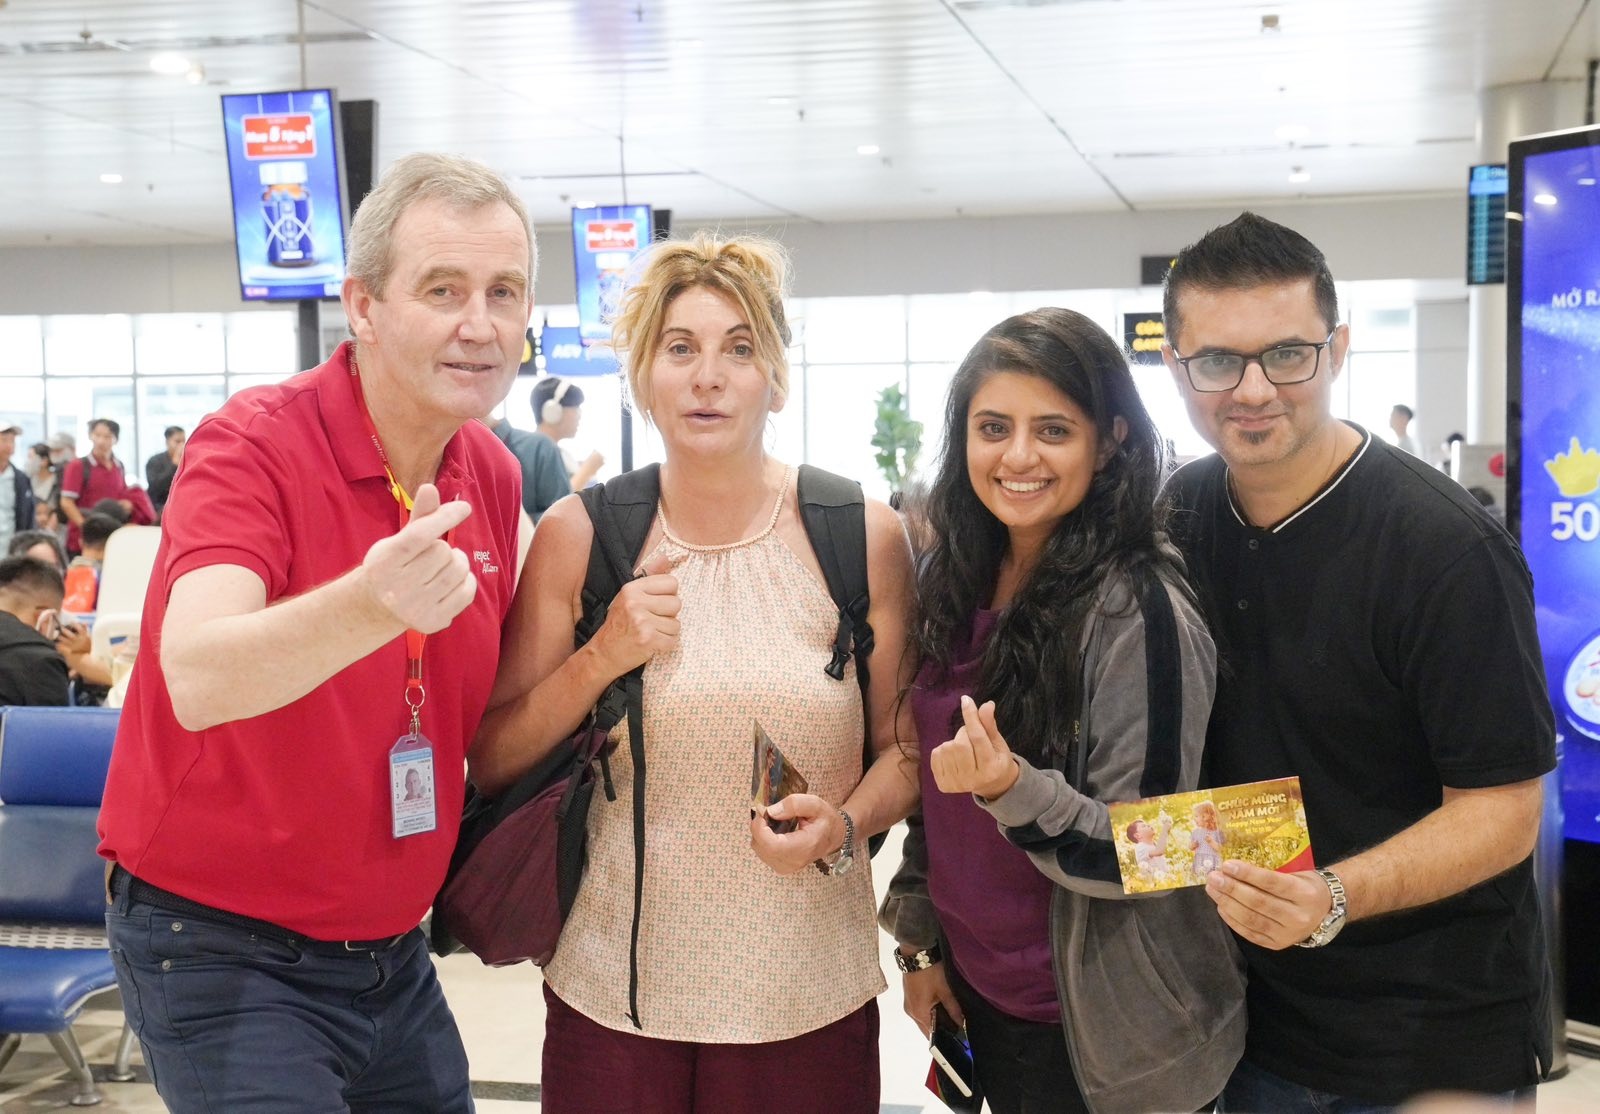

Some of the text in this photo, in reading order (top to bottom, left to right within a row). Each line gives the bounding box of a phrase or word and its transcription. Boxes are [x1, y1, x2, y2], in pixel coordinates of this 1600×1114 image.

[1551, 286, 1582, 309] MỞ
[1551, 501, 1600, 542] 50
[1218, 792, 1287, 811] CHÚC MỪNG
